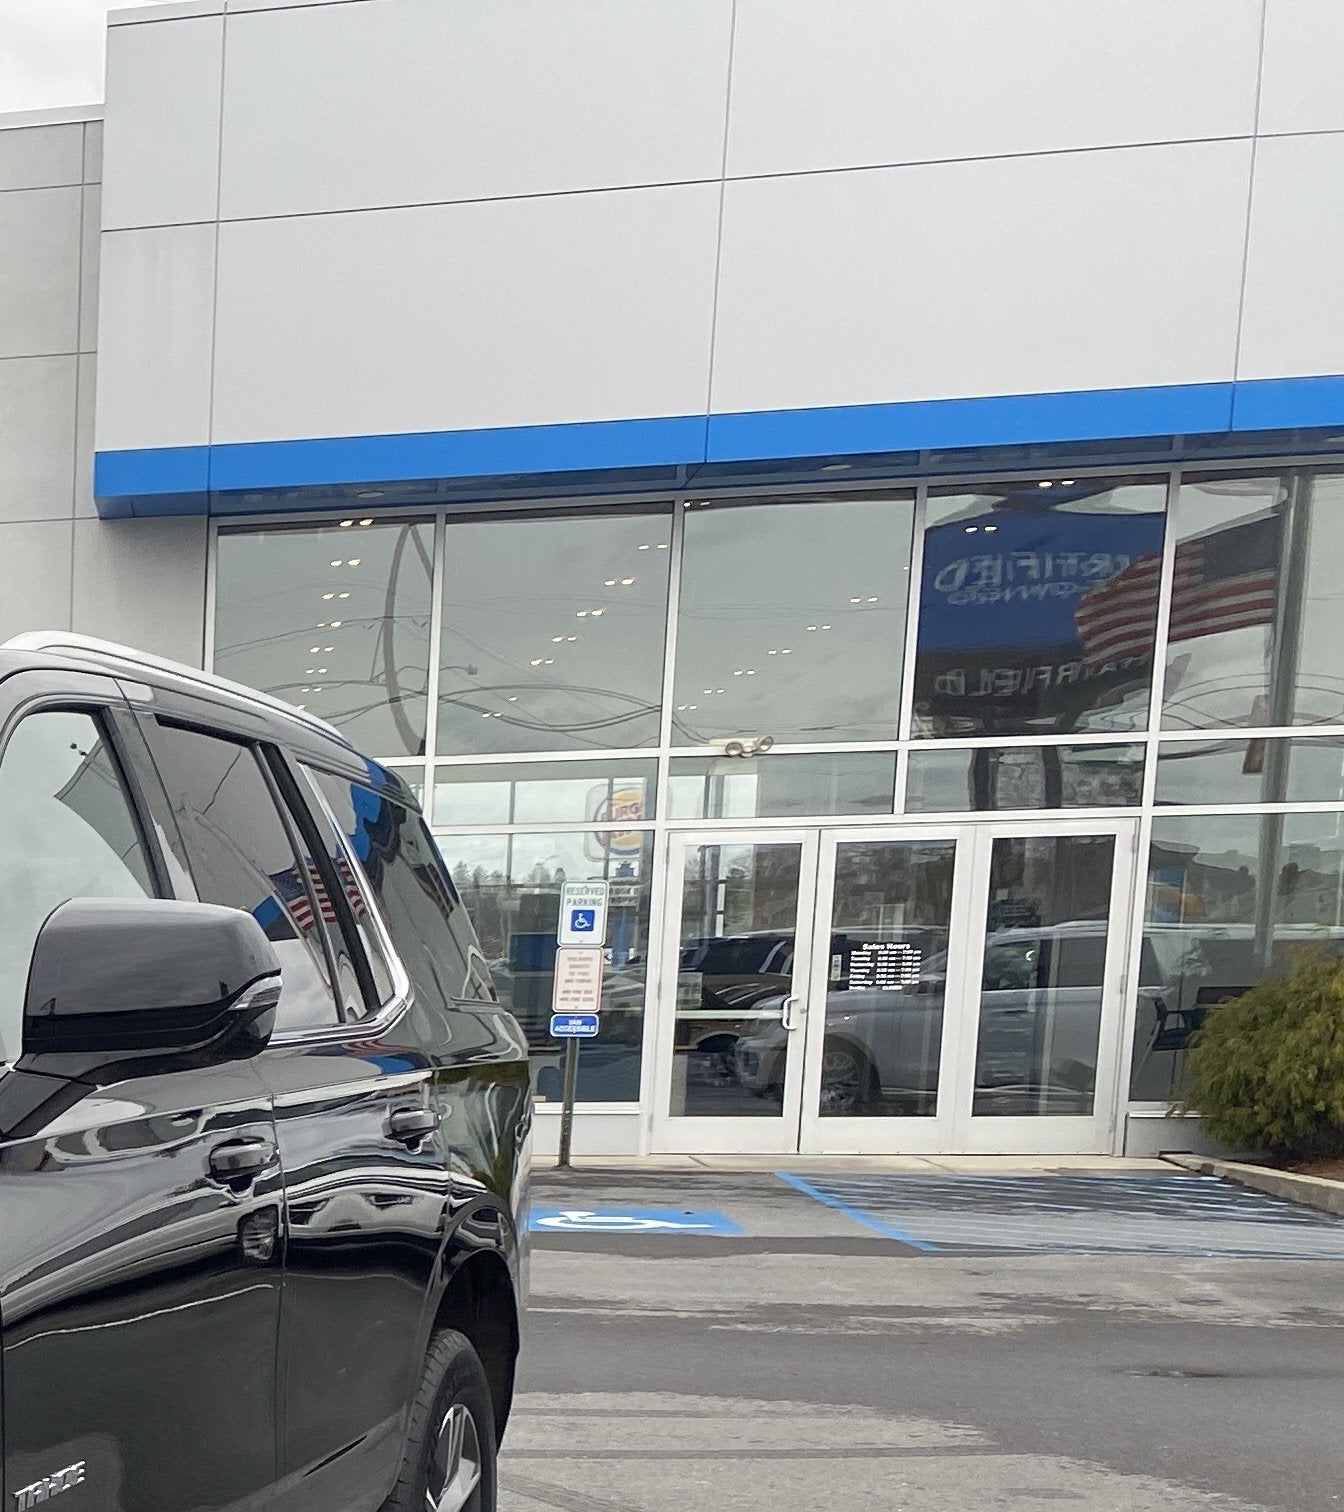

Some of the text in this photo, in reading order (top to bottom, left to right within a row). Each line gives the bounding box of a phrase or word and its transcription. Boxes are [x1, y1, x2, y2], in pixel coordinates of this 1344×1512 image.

[566, 886, 604, 896] RESERVED
[566, 897, 603, 907] PARKING
[14, 1460, 86, 1512] TAHOE
